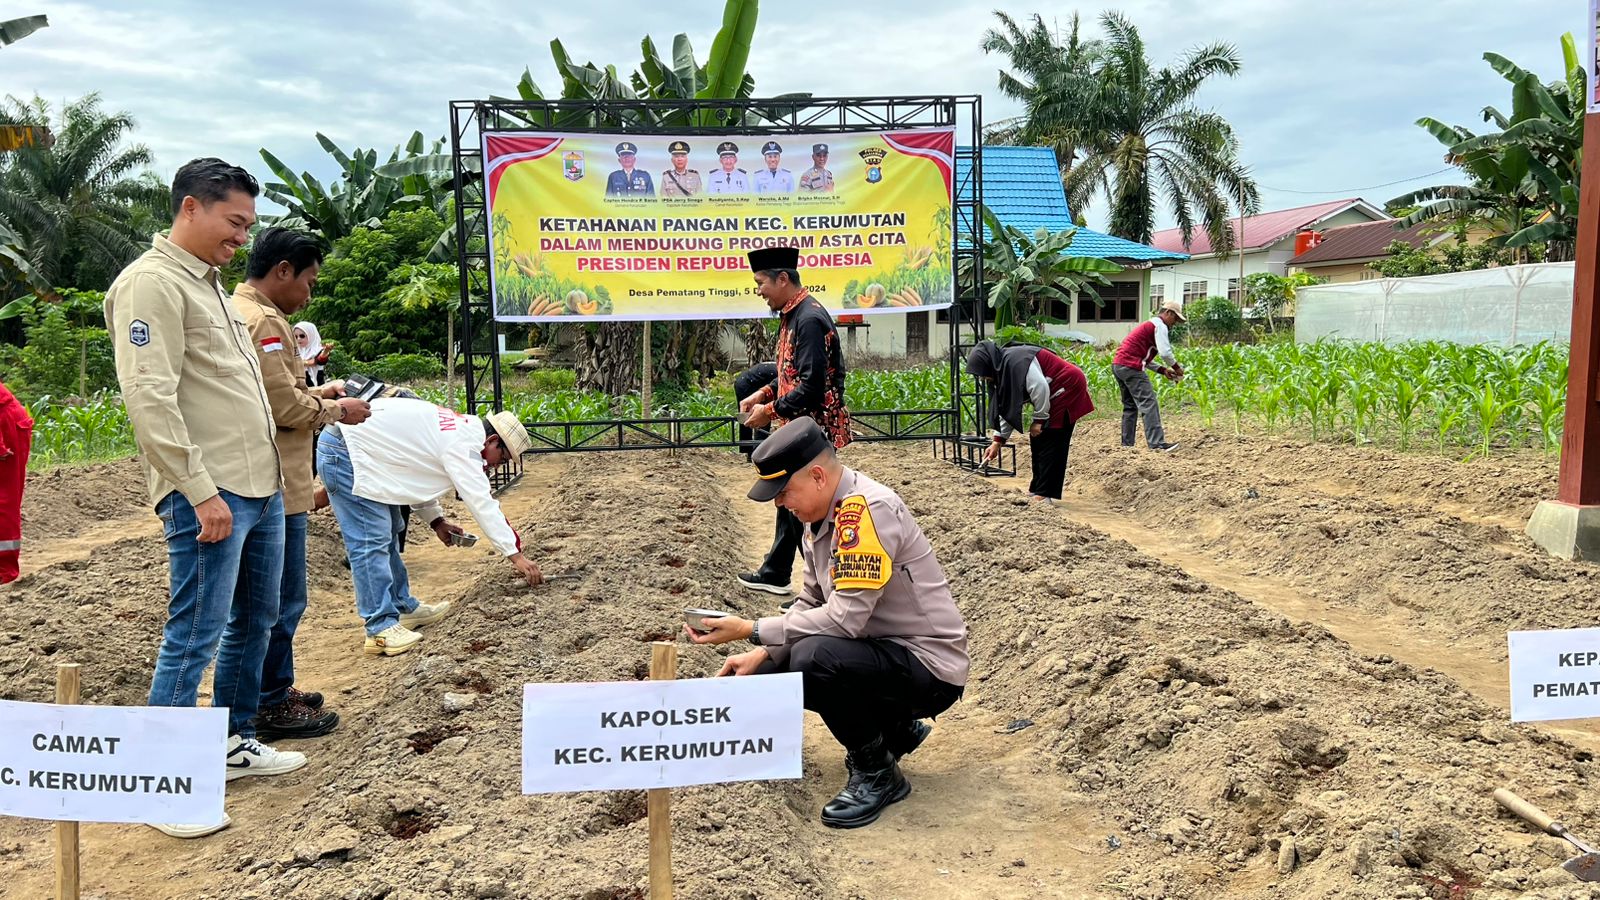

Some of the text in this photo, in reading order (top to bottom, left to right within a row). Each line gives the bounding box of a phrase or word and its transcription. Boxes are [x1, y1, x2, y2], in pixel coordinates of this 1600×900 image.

[540, 213, 905, 232] KETAHANAN PANGAN KEC. KERUMUTAN
[540, 232, 906, 251] DALAM MENDUKUNG PROGRAM ASTA CITA
[577, 253, 872, 271] PRESIDEN REPUBL DONESIA
[629, 289, 653, 297] Desa
[656, 288, 705, 298] Pematang
[708, 287, 741, 298] Tinggi,
[804, 285, 826, 293] 2024
[843, 554, 881, 564] WILAYAH
[1559, 652, 1600, 667] KEP
[601, 706, 732, 729] KAPOLSEK
[32, 733, 120, 755] CAMAT
[554, 737, 774, 765] KEC. KERUMUTAN
[28, 769, 192, 795] KERUMUTAN
